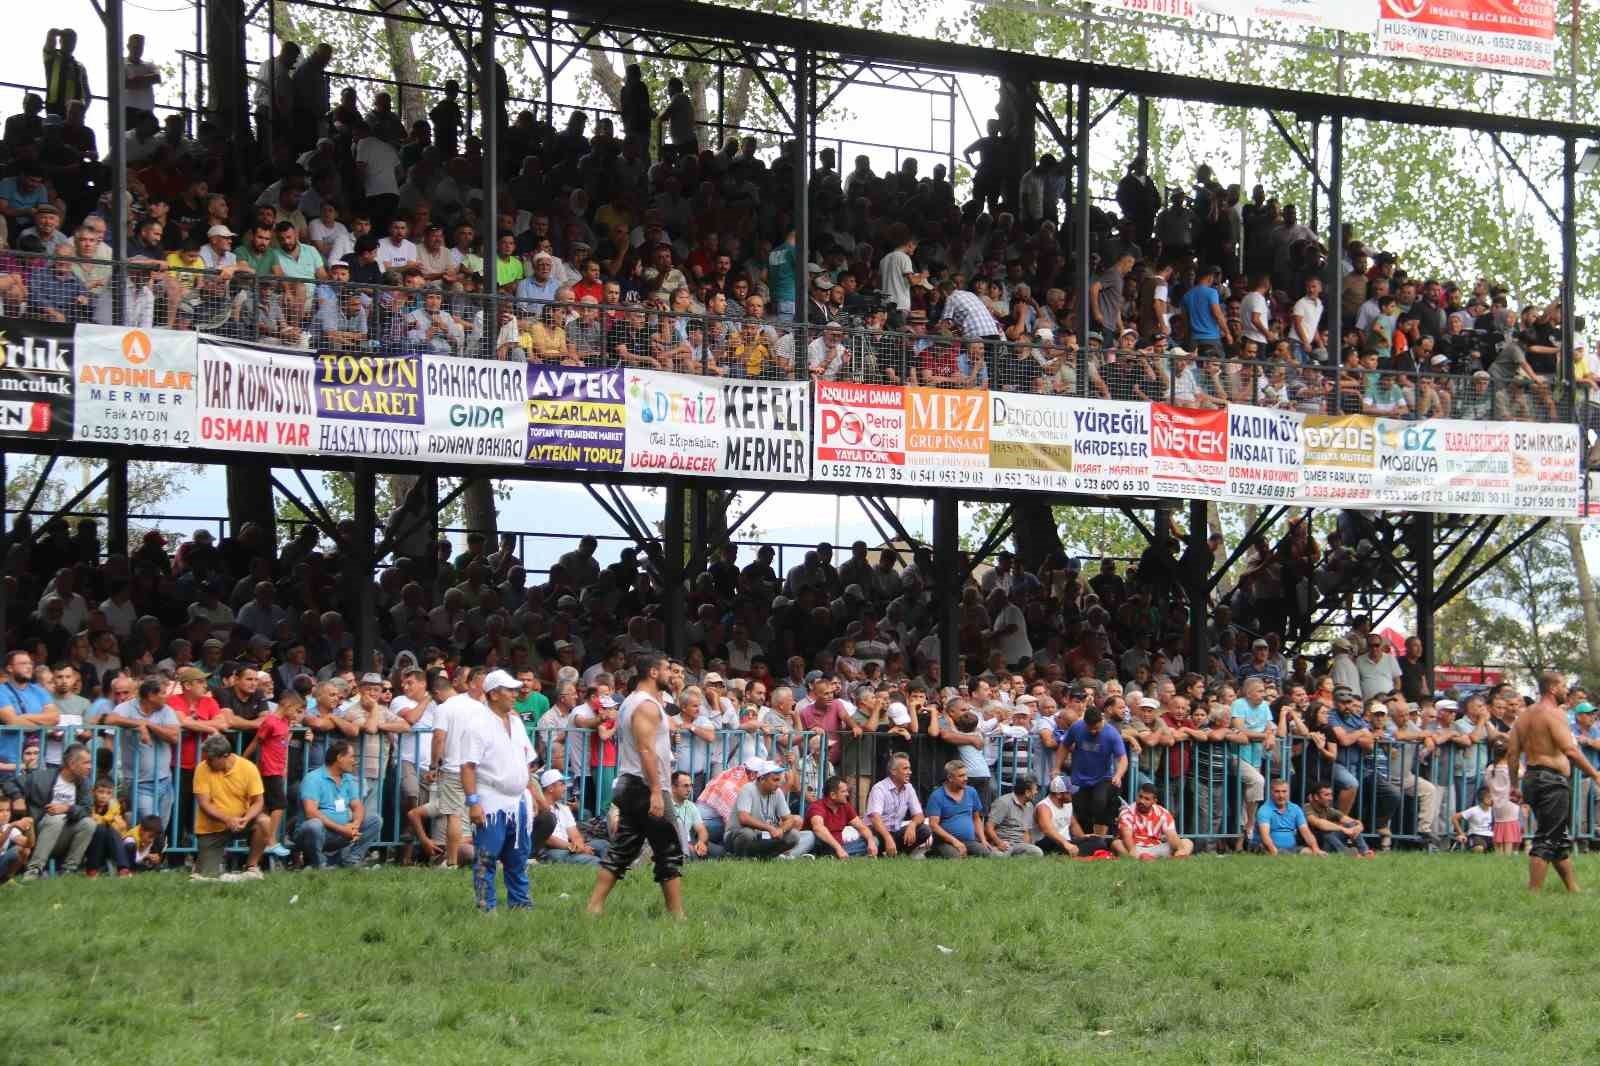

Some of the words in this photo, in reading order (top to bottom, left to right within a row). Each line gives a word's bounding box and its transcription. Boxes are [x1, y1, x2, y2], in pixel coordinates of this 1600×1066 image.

[320, 354, 417, 388] TOSUN
[427, 362, 524, 402] BAKIRCILAR
[204, 359, 232, 410] YAR
[532, 370, 621, 400] AYTEK
[90, 389, 183, 406] MERMER
[656, 391, 716, 425] DENİZ
[869, 390, 902, 406] DAMAR
[130, 410, 168, 422] AYDIN
[450, 404, 505, 428] GIDA
[529, 404, 622, 424] PAZARLAMA
[866, 413, 902, 430] Petrol
[909, 392, 985, 433] MEZ
[1074, 406, 1149, 435] YÜREĞİL
[81, 425, 89, 438] 0
[94, 426, 119, 440] 533
[124, 427, 149, 441] 310
[153, 428, 168, 441] 81
[174, 430, 190, 443] 42
[201, 416, 268, 444] OSMAN
[276, 422, 310, 447] YAR
[319, 424, 368, 453] HASAN
[372, 428, 419, 456] TOSUN
[1231, 414, 1299, 442] KADIKÖY
[429, 434, 474, 454] ADNAN
[476, 437, 523, 458] BAKIRCI
[910, 433, 942, 449] GRUP
[528, 443, 580, 462] AYTEKİN
[583, 446, 623, 465] TOPUZ
[630, 451, 667, 469] UĞUR
[670, 452, 717, 472] ÖLECEK
[725, 436, 805, 475] MERMER
[821, 464, 829, 477] 0
[832, 464, 851, 478] 552
[855, 465, 872, 479] 776
[875, 466, 885, 479] 21
[1228, 466, 1261, 480] OSMAN
[1231, 482, 1237, 494] 0
[1239, 482, 1255, 495] 532
